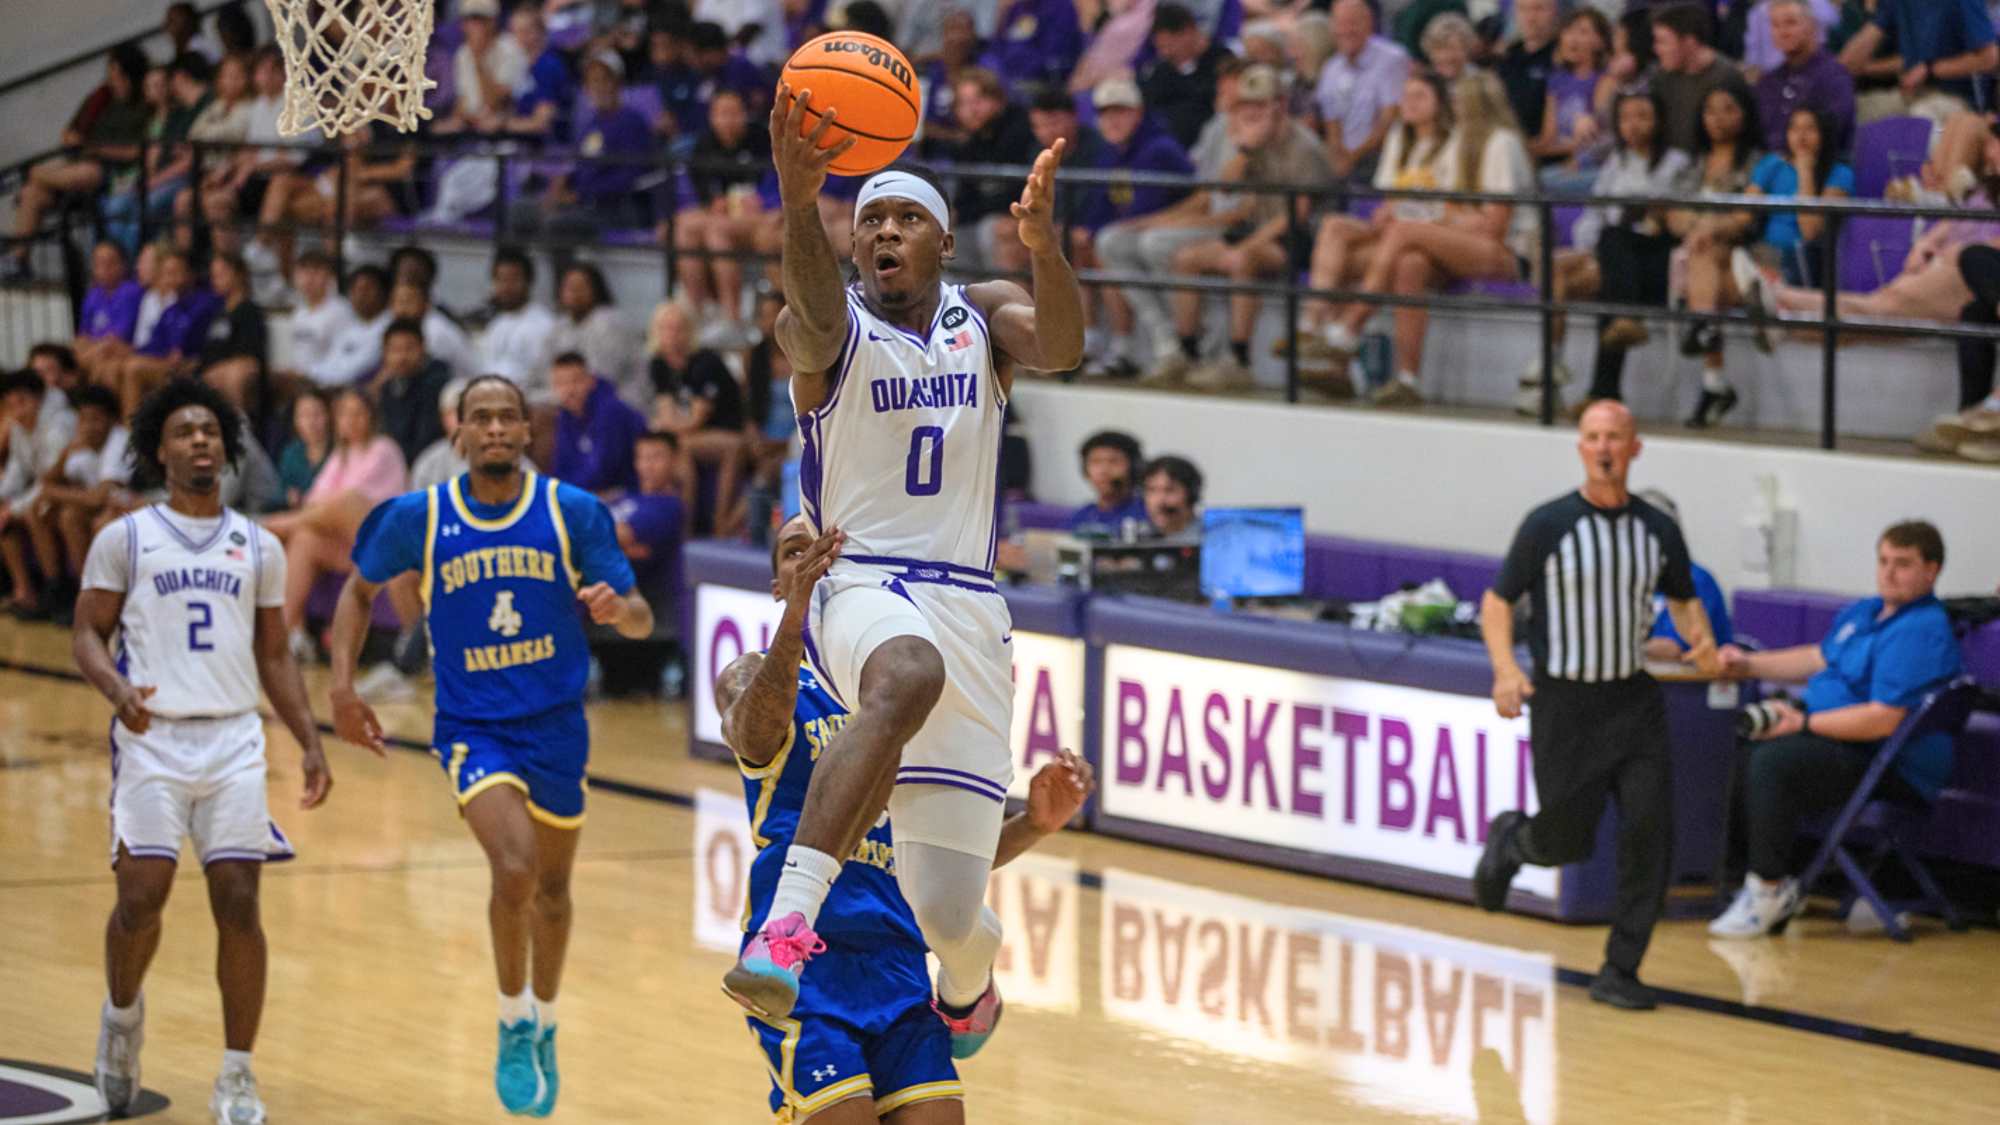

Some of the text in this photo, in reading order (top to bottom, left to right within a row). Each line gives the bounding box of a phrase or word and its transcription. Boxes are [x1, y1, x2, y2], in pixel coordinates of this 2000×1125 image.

[824, 40, 912, 92] Wilson
[945, 309, 963, 326] BV
[871, 373, 978, 413] OUACHITA
[905, 426, 944, 496] 0
[153, 568, 241, 597] OUACHITA
[440, 545, 556, 594] SOUTHERN
[187, 602, 214, 650] 2
[488, 590, 522, 637] 4
[464, 634, 555, 672] ARKANSAS
